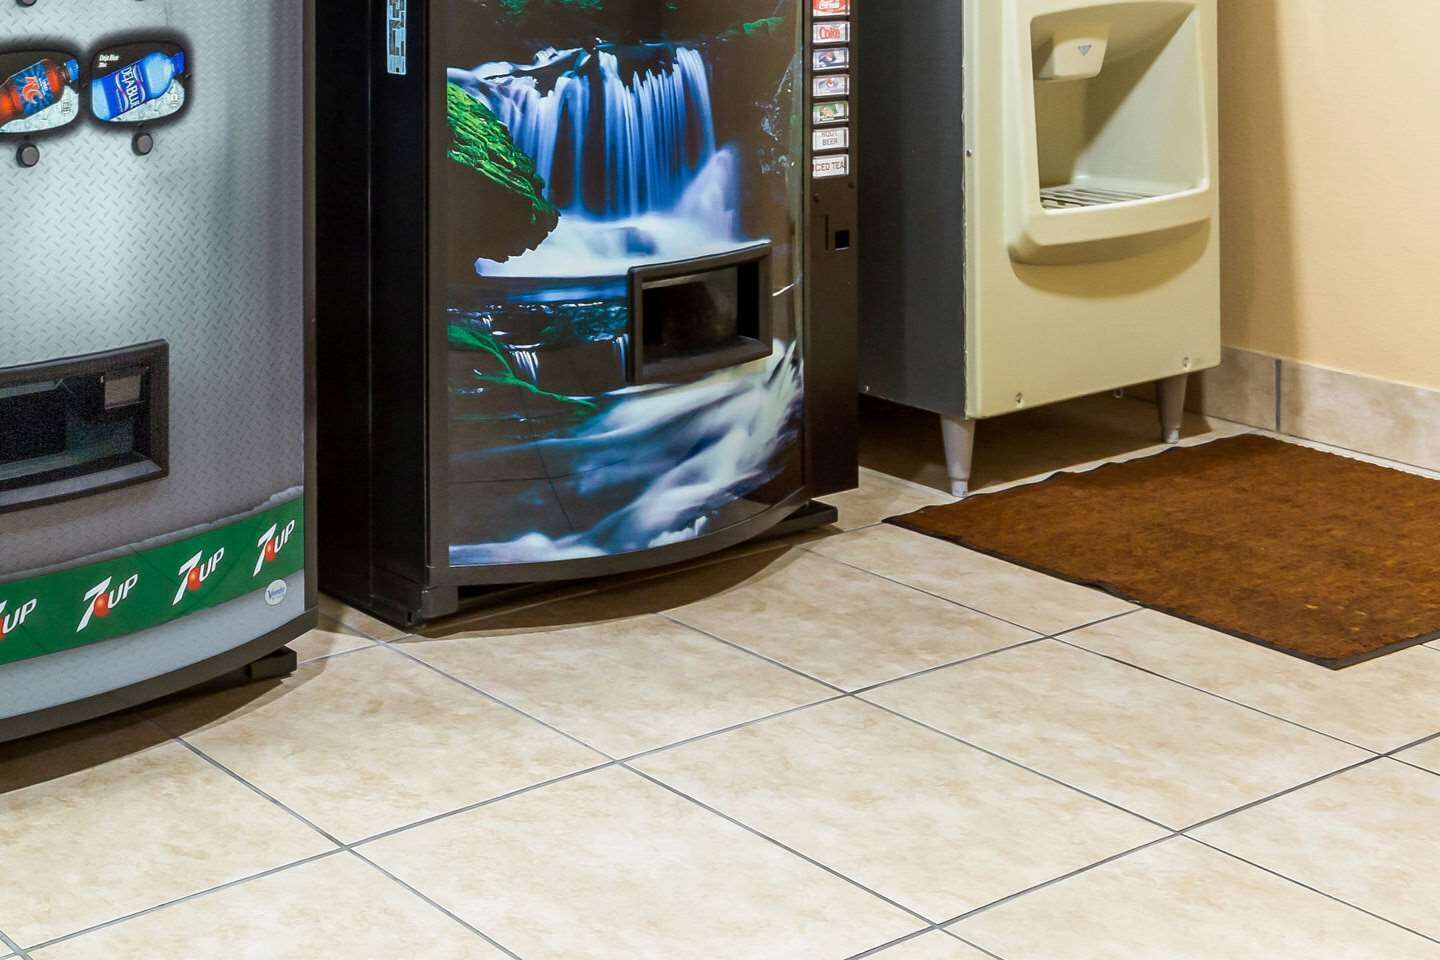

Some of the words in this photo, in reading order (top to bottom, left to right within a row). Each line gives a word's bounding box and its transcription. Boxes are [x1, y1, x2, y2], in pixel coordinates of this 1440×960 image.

[822, 138, 838, 146] BEER
[831, 160, 847, 170] TEA
[171, 546, 225, 607] 7UP
[252, 519, 296, 577] 7UP
[75, 573, 139, 633] 7UP
